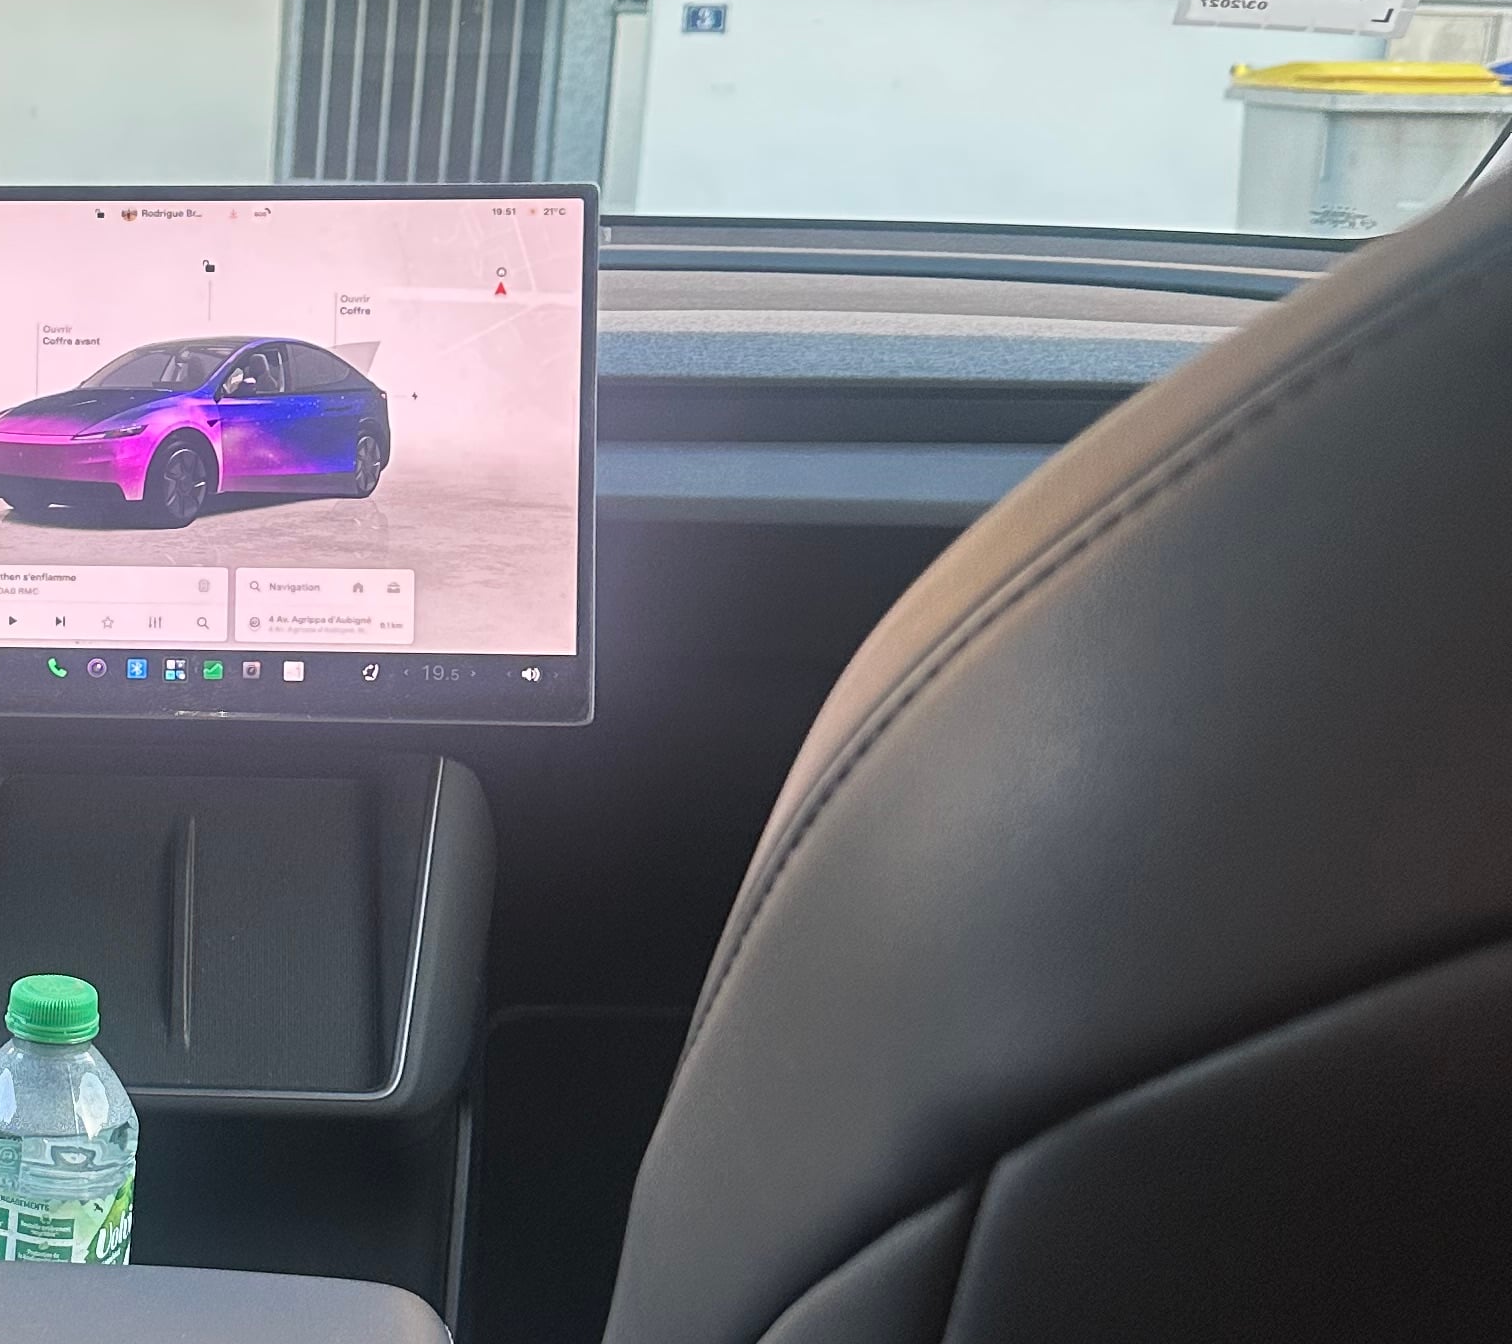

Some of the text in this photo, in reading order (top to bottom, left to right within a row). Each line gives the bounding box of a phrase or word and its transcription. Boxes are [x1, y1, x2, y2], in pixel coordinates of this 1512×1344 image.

[141, 209, 184, 219] Rodrigue
[492, 207, 517, 216] 19:51
[543, 207, 567, 216] 21°C
[340, 294, 371, 303] Ouvrir
[340, 306, 371, 316] Coffre
[43, 324, 73, 334] Ouvrir
[42, 336, 100, 346] Coffre avant
[269, 582, 321, 593] Navigation
[421, 665, 460, 681] 19.5
